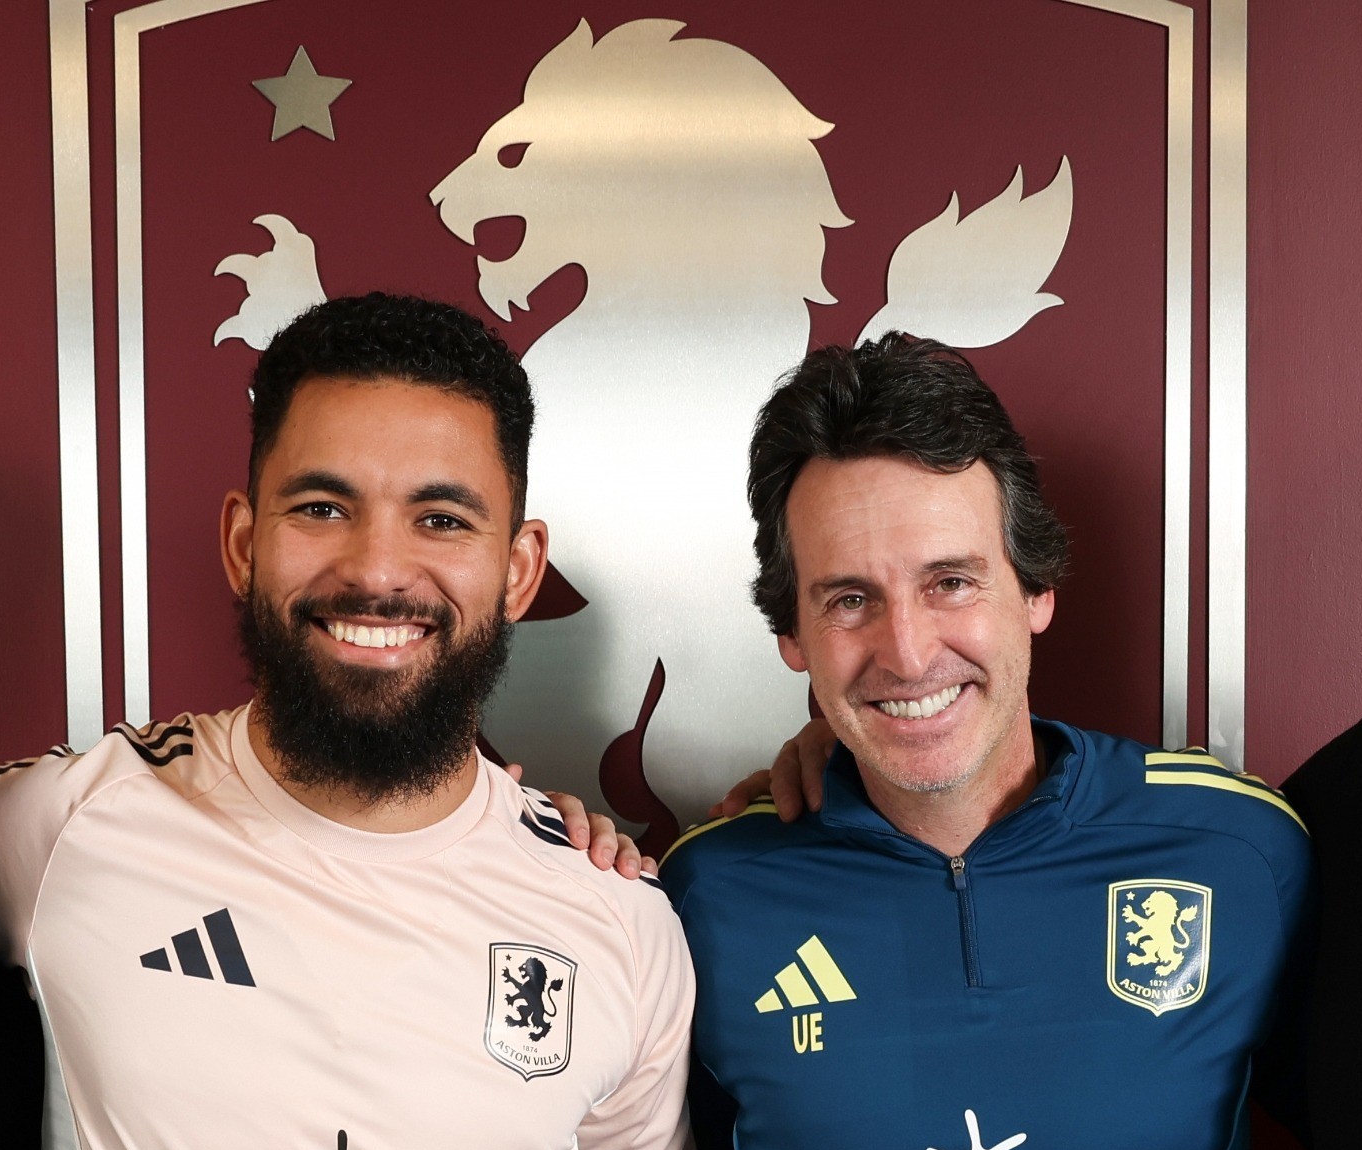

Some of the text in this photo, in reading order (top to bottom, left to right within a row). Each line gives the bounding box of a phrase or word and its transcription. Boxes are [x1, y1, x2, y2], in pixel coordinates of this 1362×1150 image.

[1119, 978, 1195, 1000] ASTON VILLA
[1149, 979, 1168, 987] 1874
[792, 1012, 824, 1054] UE
[495, 1040, 561, 1066] ASTON VILLA
[522, 1045, 538, 1053] 1874
